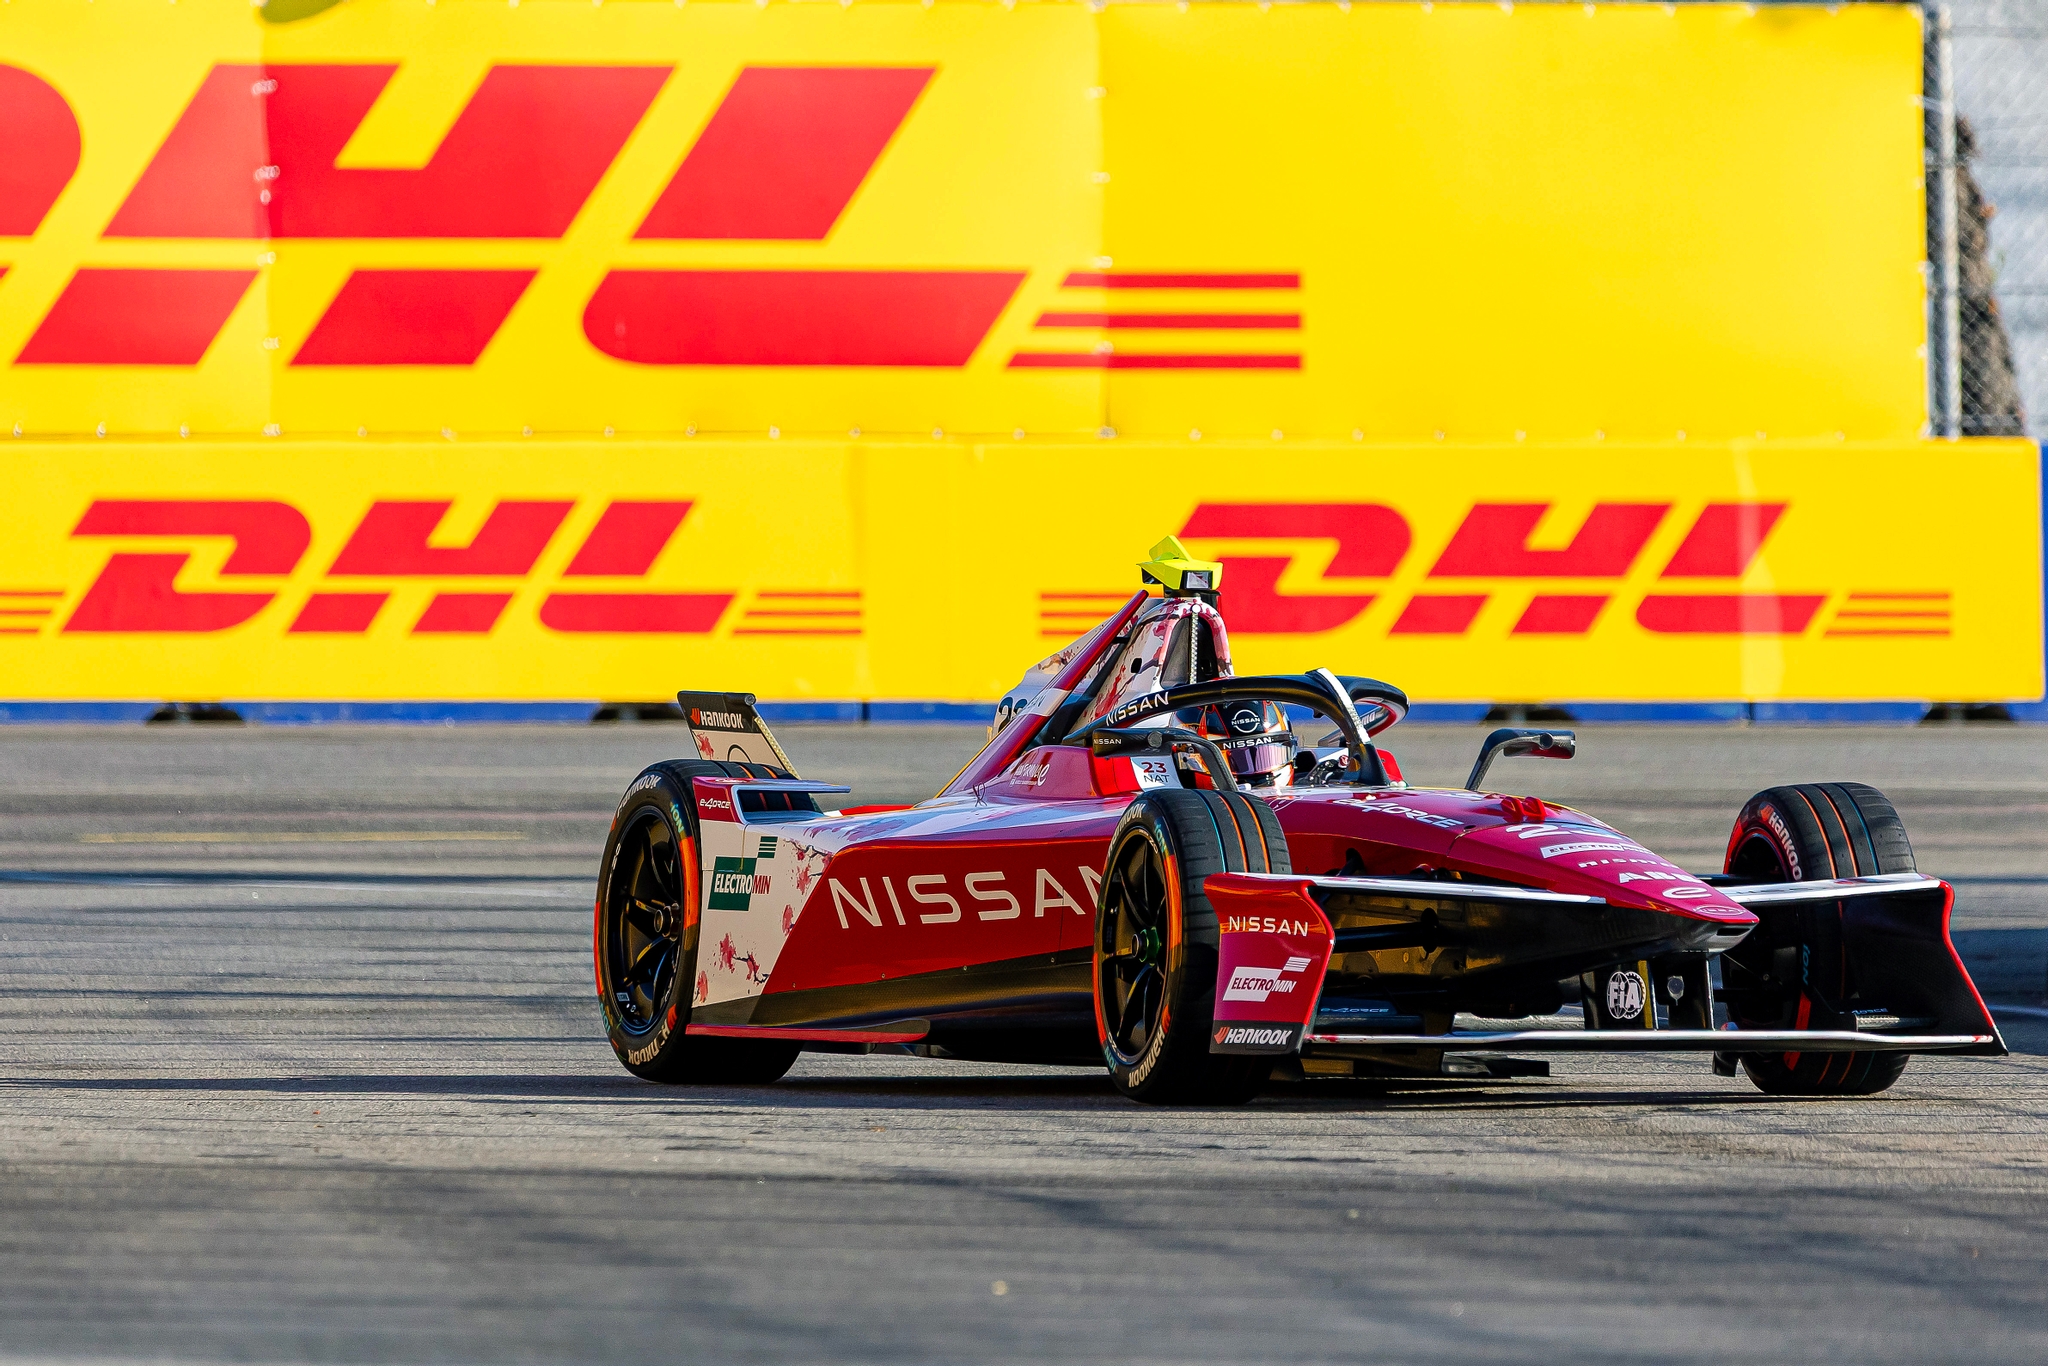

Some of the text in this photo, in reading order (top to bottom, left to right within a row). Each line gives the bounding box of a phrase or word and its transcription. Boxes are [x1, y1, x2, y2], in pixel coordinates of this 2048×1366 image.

[60, 500, 735, 635] DHL
[1175, 502, 1827, 637] DHL
[1106, 692, 1169, 727] NISSAN
[1231, 717, 1260, 725] NISSAN
[1223, 737, 1272, 750] NISSAN
[1141, 762, 1167, 773] 23
[1144, 775, 1169, 783] NAT
[1768, 812, 1802, 880] HanKOO
[1228, 916, 1308, 937] NISSAN
[1231, 978, 1297, 993] ELECTROMIN
